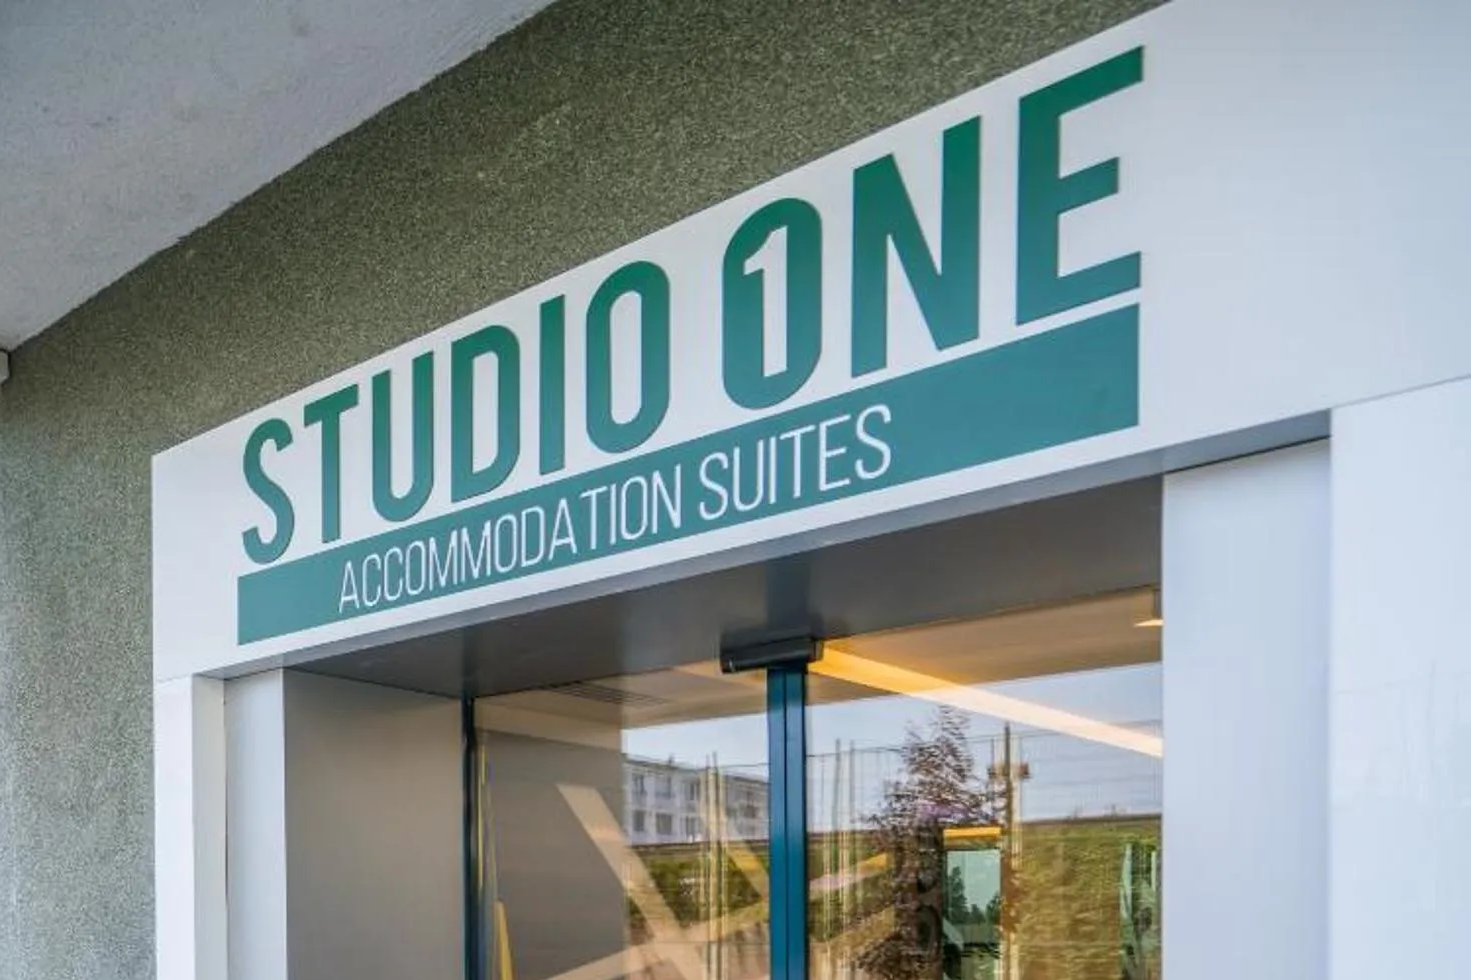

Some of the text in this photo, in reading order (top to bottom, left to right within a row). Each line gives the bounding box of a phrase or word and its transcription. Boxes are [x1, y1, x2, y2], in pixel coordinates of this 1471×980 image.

[242, 45, 1144, 566] STUDIO ONE
[337, 403, 892, 615] ACCOMMODATION SUITES
